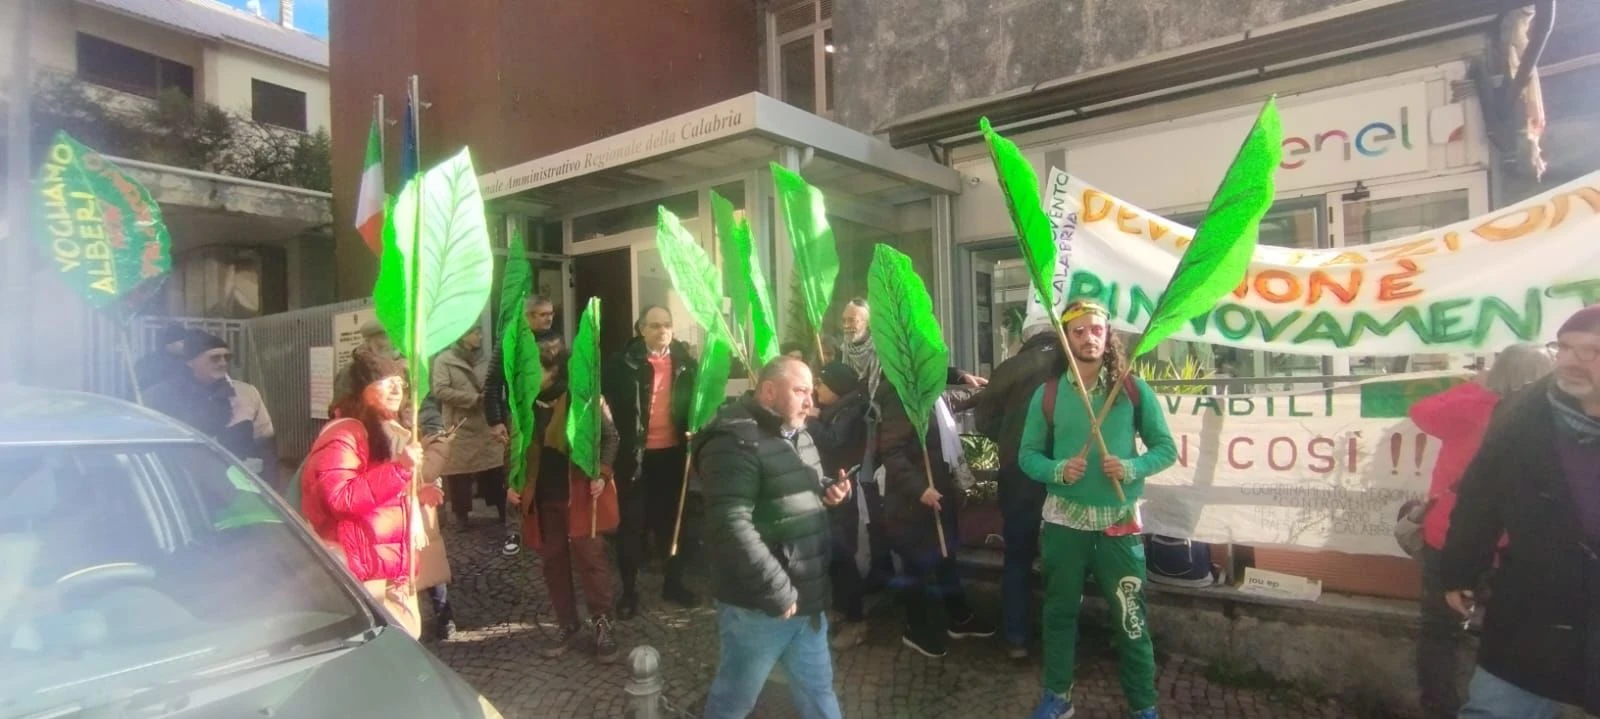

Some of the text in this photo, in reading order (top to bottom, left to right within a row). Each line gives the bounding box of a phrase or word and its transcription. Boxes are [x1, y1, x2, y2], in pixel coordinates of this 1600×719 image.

[508, 160, 581, 189] Amministrativo
[584, 140, 643, 169] Regionale
[645, 129, 677, 151] della
[680, 110, 742, 140] Calabria
[1279, 106, 1413, 170] enel
[70, 191, 119, 295] ALBERI
[1165, 395, 1334, 418] VABILI
